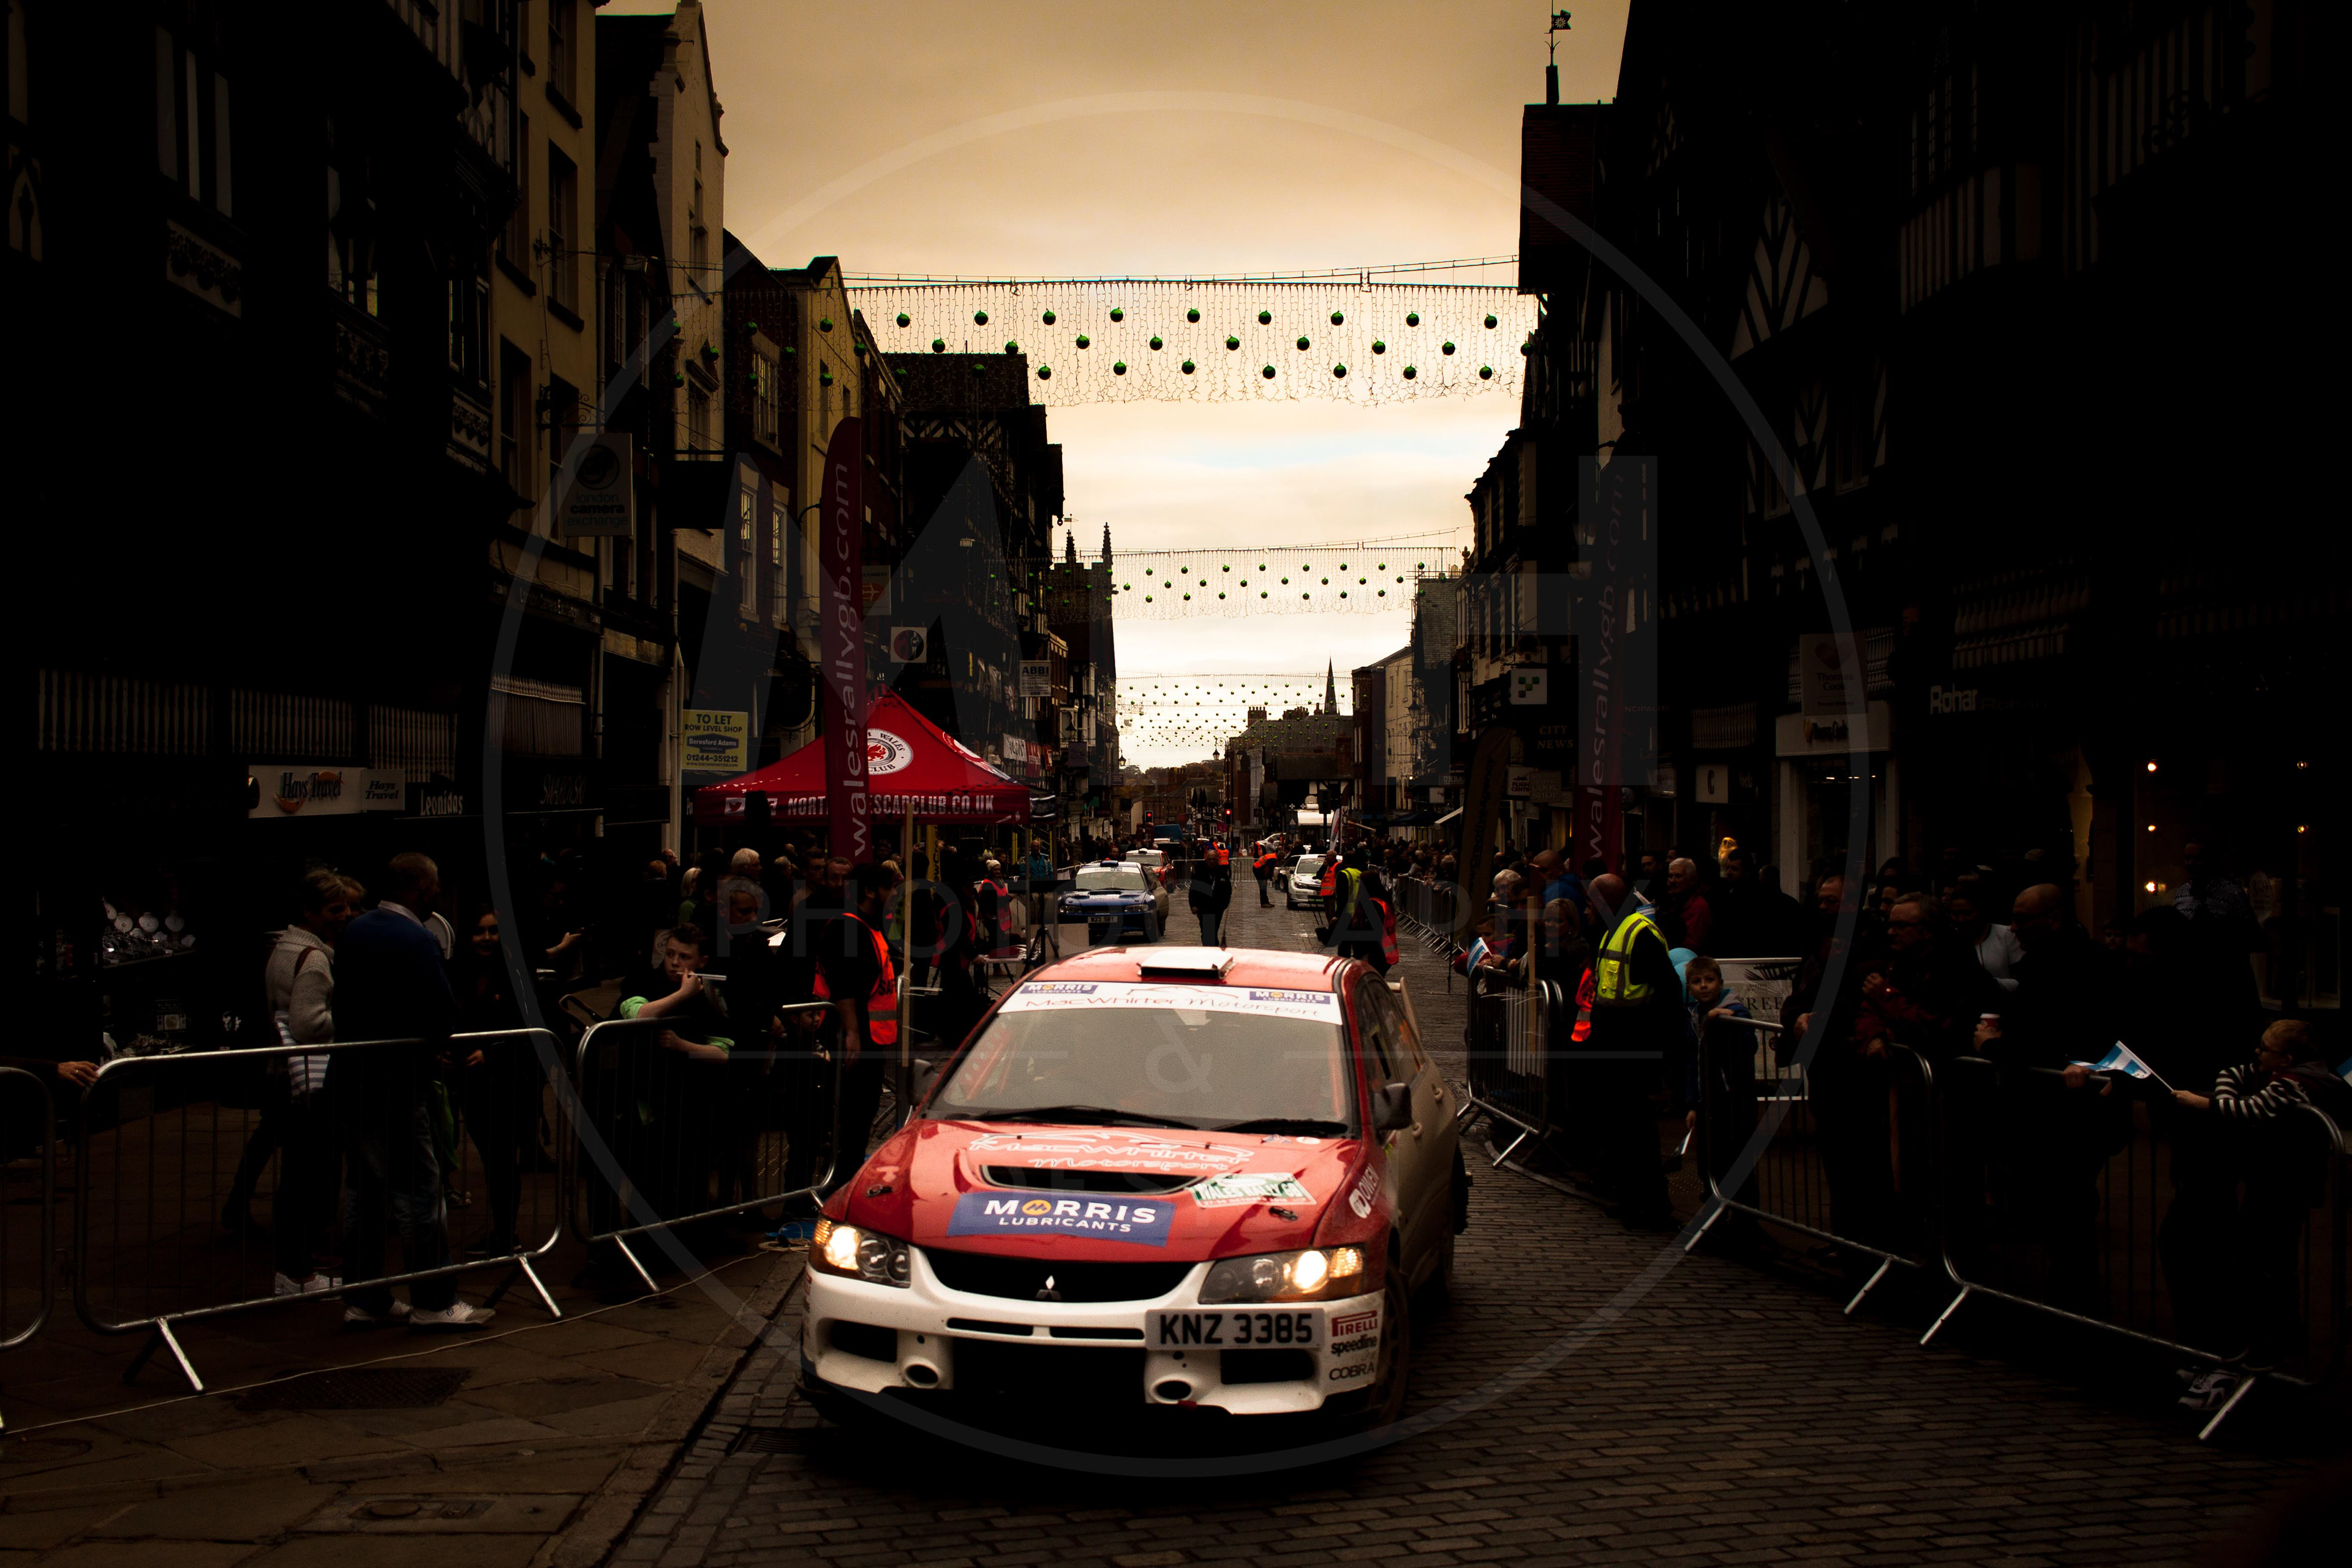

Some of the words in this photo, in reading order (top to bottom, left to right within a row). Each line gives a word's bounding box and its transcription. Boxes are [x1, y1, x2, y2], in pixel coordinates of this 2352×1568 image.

[576, 492, 618, 502] london
[571, 505, 625, 513] camera
[567, 516, 628, 527] exchange
[834, 463, 867, 856] walesrallygb.com
[1823, 681, 1846, 690] Cook
[696, 714, 710, 724] TO
[715, 714, 732, 725] LET
[1539, 725, 1567, 735] CITY
[880, 733, 905, 752] WALES
[1536, 739, 1575, 749] NEWS
[687, 754, 738, 763] 01244-351212
[282, 772, 308, 805] Hays
[311, 772, 342, 798] Travel
[369, 780, 396, 790] Hays
[366, 790, 399, 799] Travel
[420, 789, 464, 816] Leonidas
[1256, 991, 1325, 1001] MORRIS
[1026, 997, 1174, 1007] MacWhirter
[1741, 997, 1783, 1010] REE
[984, 1199, 1156, 1224] MORRIS
[999, 1216, 1131, 1233] LUBRICANTS
[1159, 1314, 1223, 1344] KNZ
[1233, 1313, 1313, 1344] 3385
[1332, 1310, 1378, 1336] PIRELLI
[1329, 1362, 1375, 1381] COBRA
